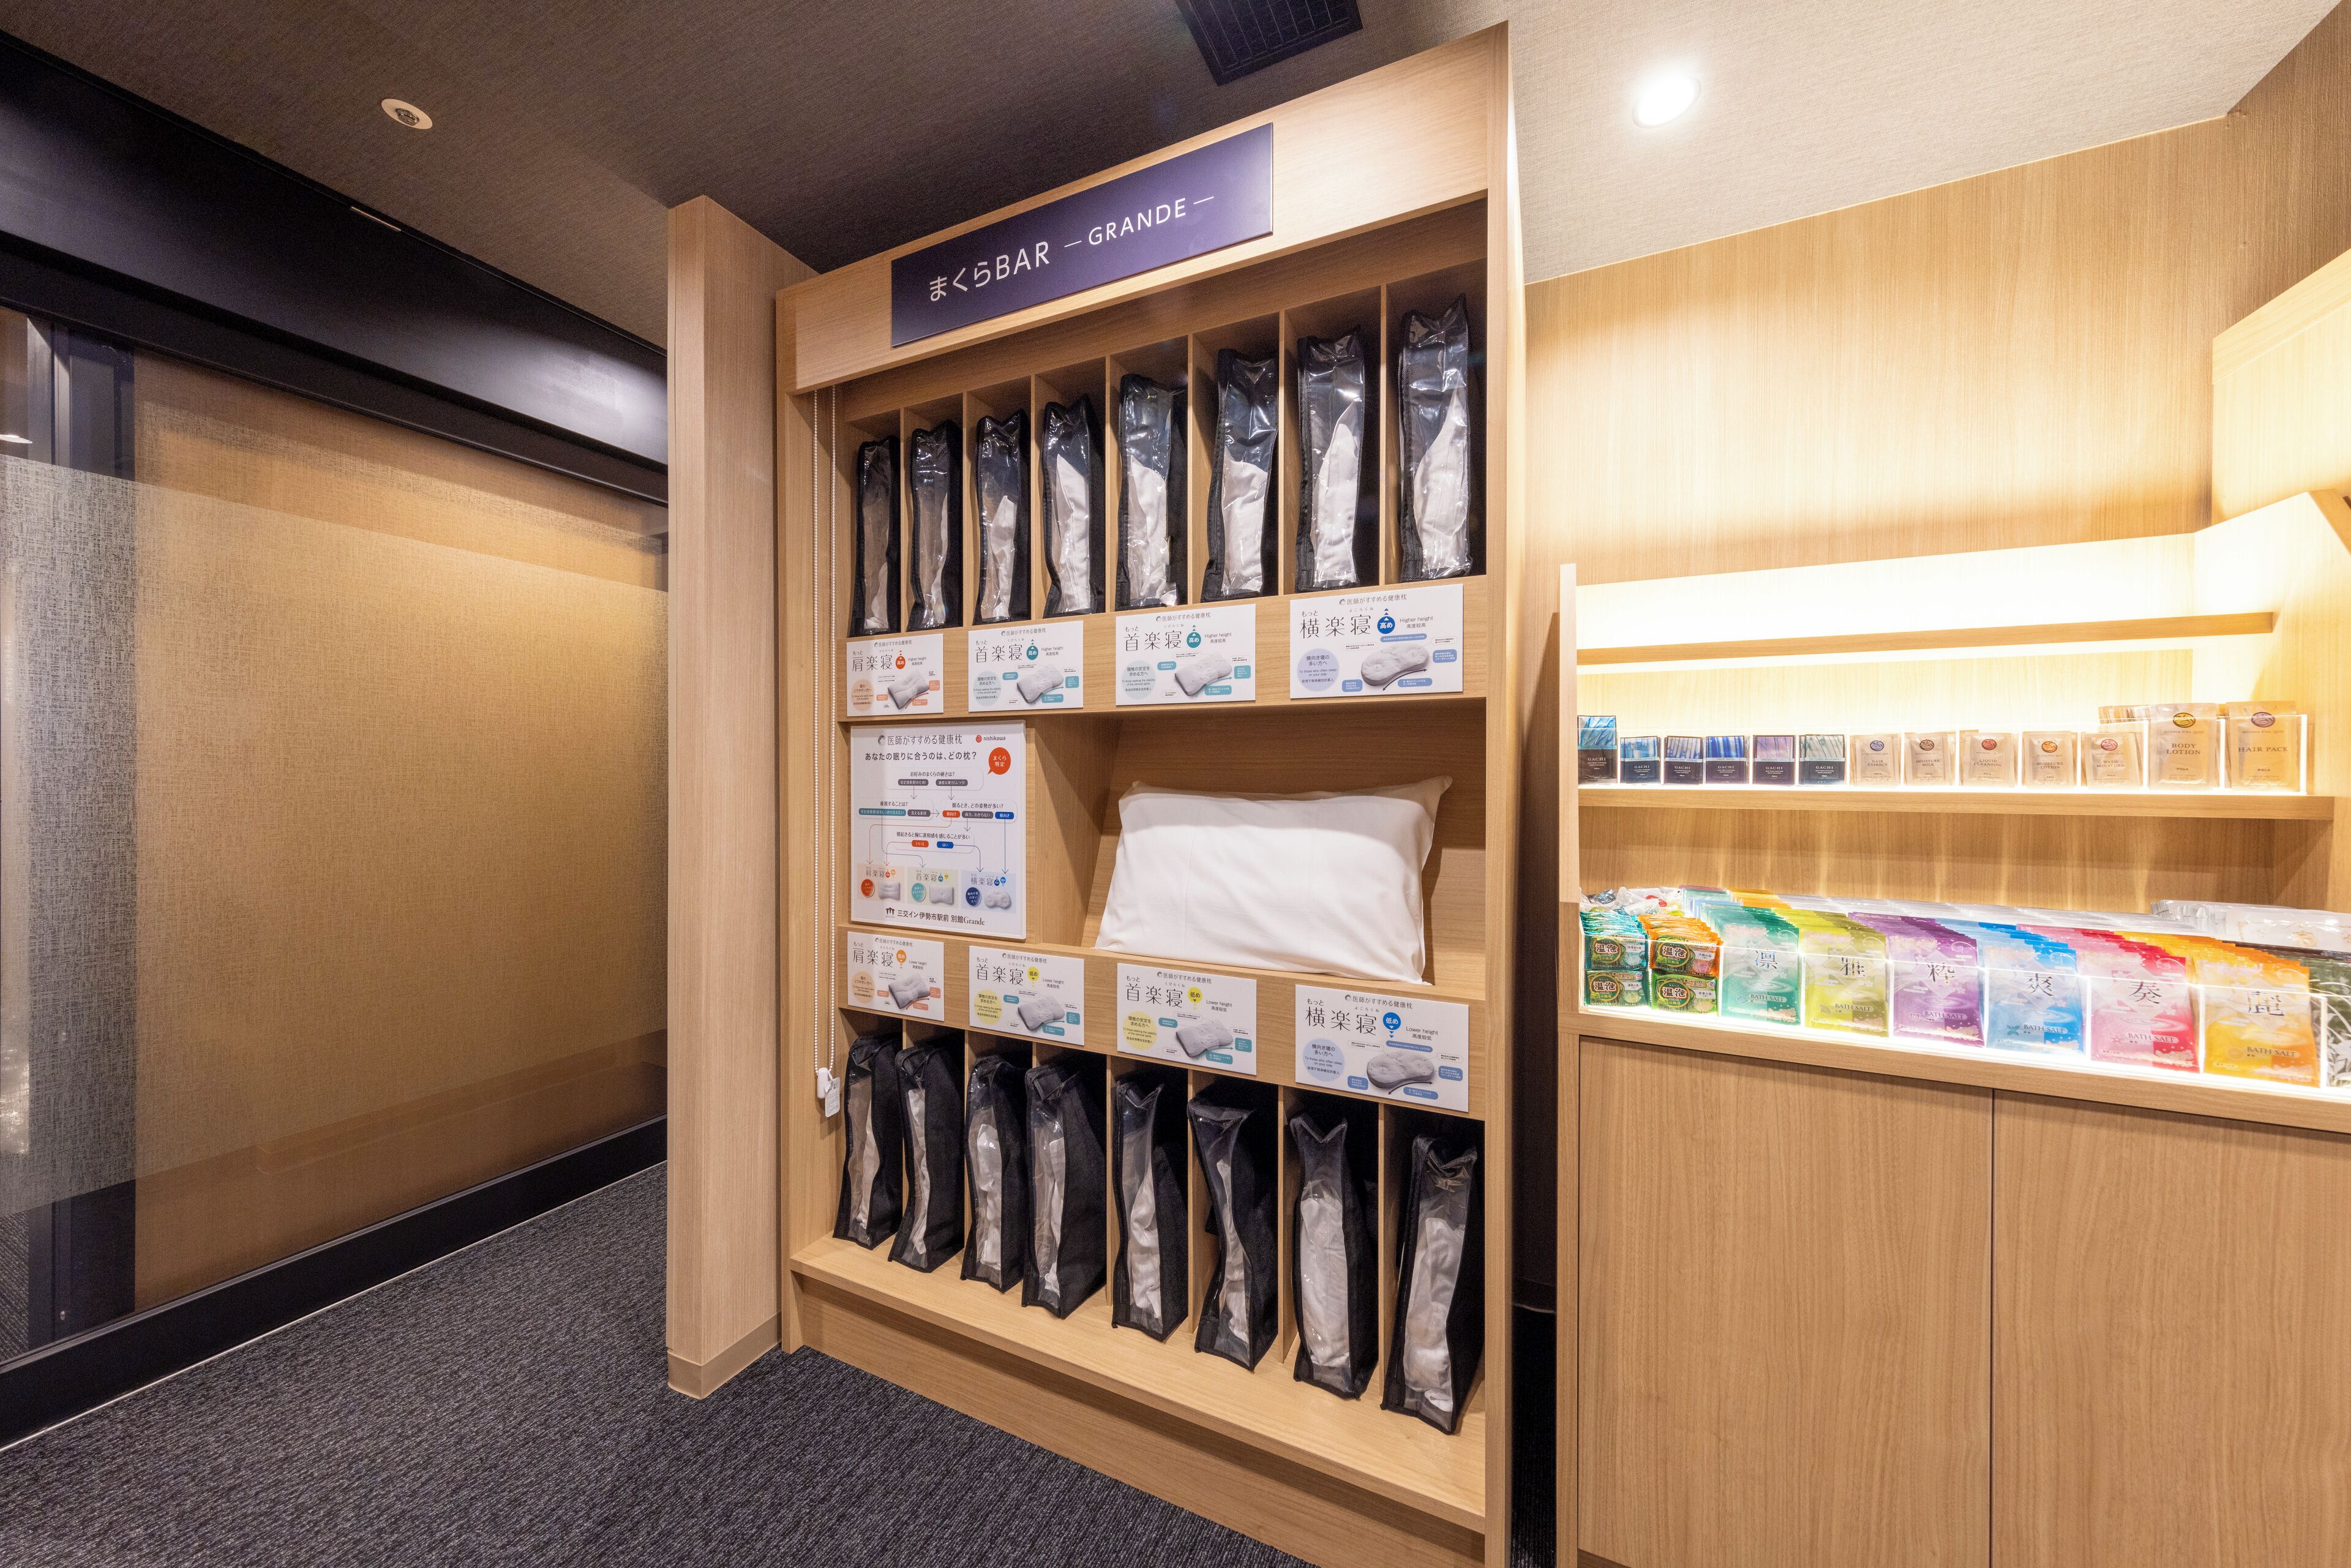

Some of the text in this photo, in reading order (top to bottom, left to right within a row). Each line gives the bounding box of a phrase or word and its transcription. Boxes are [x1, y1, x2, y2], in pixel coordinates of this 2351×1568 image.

[929, 240, 1051, 302] まくらBAR
[1347, 594, 1407, 605] 医師がすすめる健康枕
[1162, 612, 1211, 621] 医師がすすめる健康枕
[1300, 615, 1371, 639] 横楽寝
[1125, 631, 1181, 651] 首楽寝
[975, 644, 1022, 662] 首楽寝
[852, 655, 892, 672] 肩楽寝
[888, 735, 962, 745] 医師がすすめる健康枕
[853, 948, 893, 967] 肩楽寝
[1007, 955, 1047, 963] 医師がすすめる健康枕
[1664, 947, 1685, 957] 温泡
[976, 964, 1023, 986] 首楽寝
[1163, 973, 1212, 984] 医師がすすめる健康枕
[1927, 962, 1955, 983] 粋
[1664, 988, 1685, 997] 温泡
[2025, 973, 2054, 996] 爽
[2128, 980, 2162, 1004] 奏
[1125, 983, 1182, 1008] 首楽寝
[1353, 996, 1413, 1009] 医師がすすめる健康枕
[1305, 1007, 1376, 1035] 横楽寝
